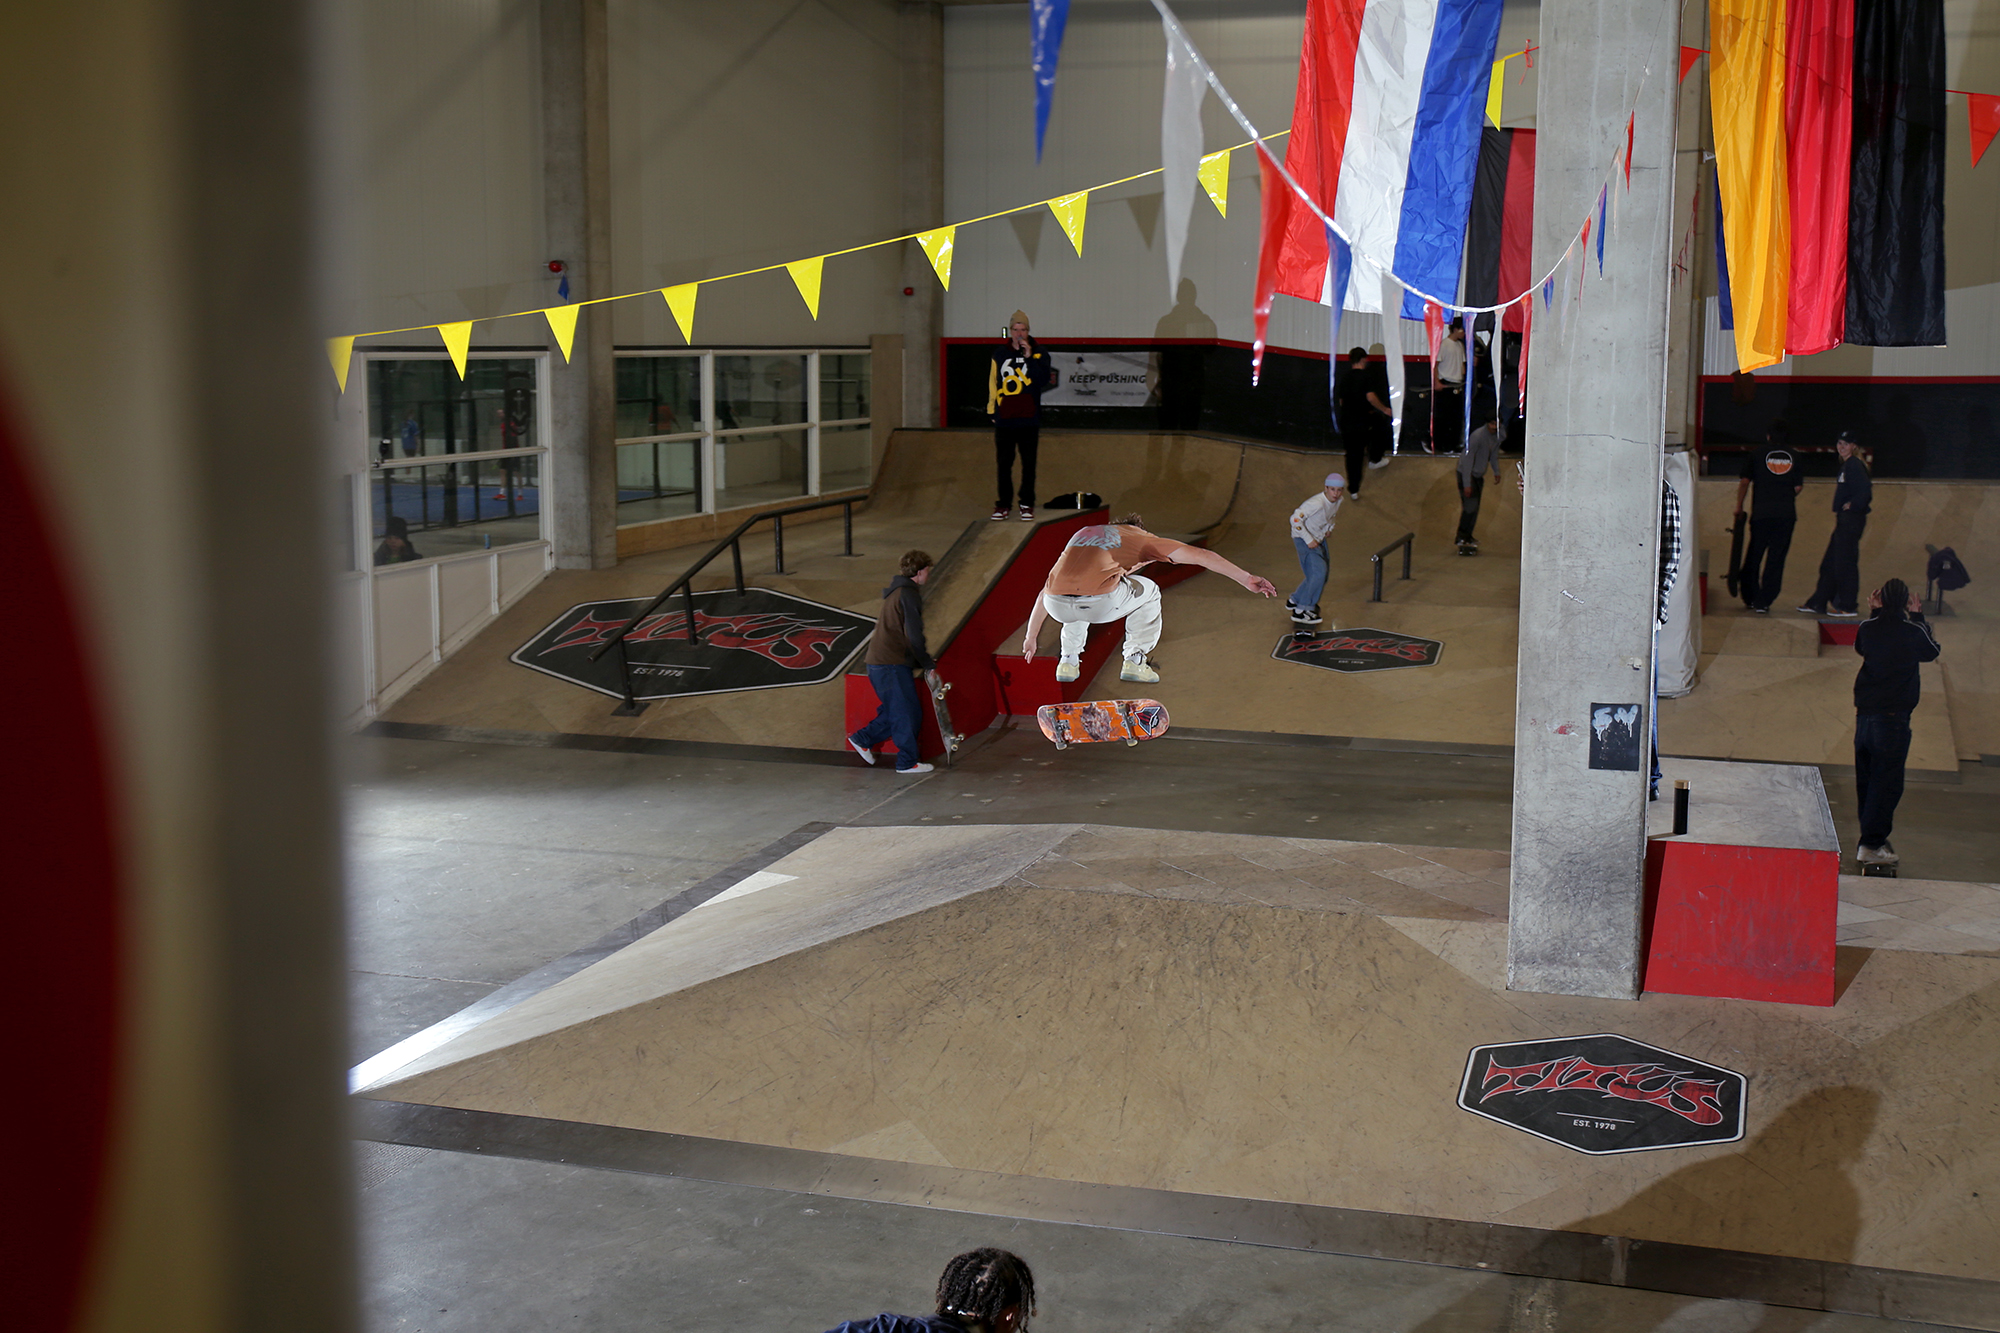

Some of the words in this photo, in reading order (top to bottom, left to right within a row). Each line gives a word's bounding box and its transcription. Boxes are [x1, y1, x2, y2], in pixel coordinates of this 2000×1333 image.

[1069, 375, 1096, 383] KEEP
[1099, 375, 1147, 383] PUSHING
[658, 669, 684, 677] 1978
[1573, 1119, 1591, 1128] EST.
[1594, 1121, 1616, 1130] 1978
